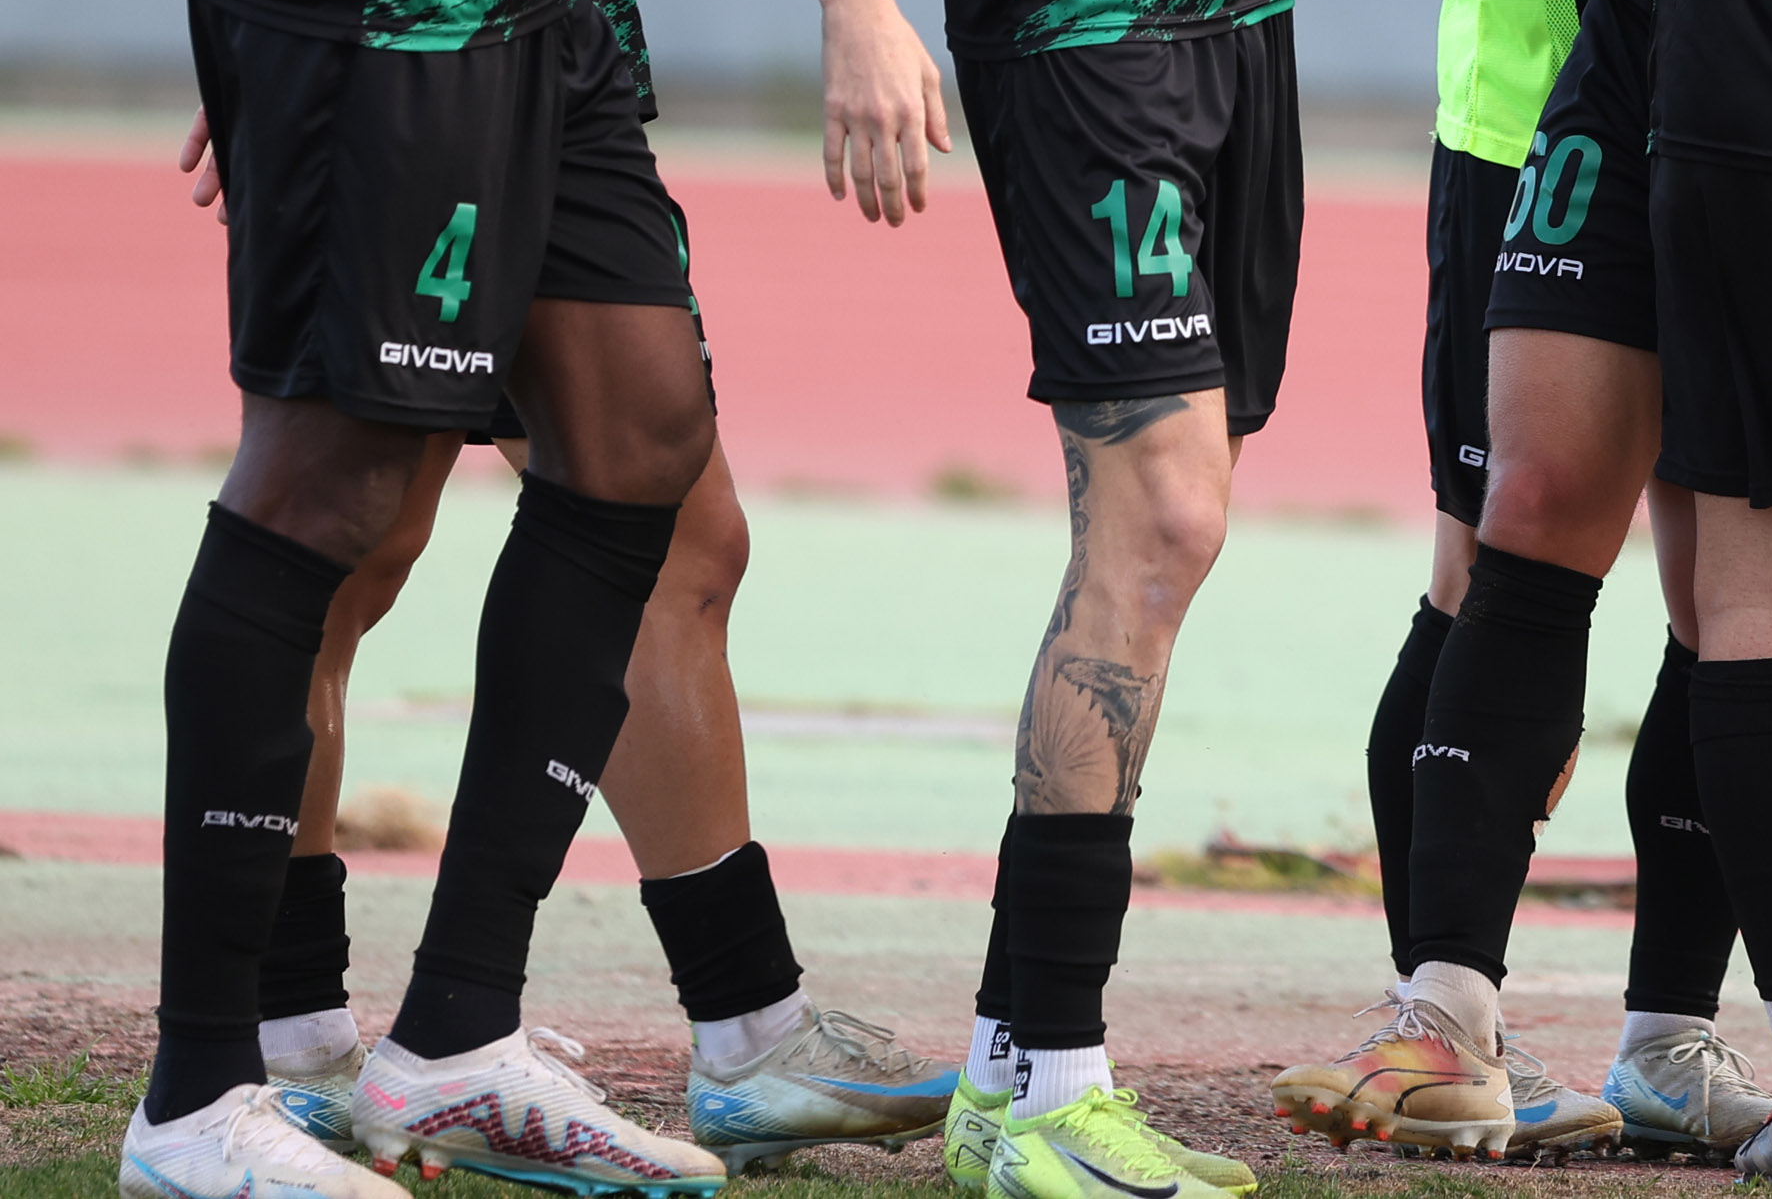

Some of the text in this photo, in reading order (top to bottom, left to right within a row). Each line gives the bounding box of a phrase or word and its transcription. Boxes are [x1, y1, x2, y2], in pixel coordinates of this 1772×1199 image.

[1091, 179, 1194, 298] 14
[415, 202, 478, 323] 4
[1086, 313, 1212, 346] GIVOVA
[379, 341, 494, 374] GIVOVA
[201, 810, 299, 837] GIVOV
